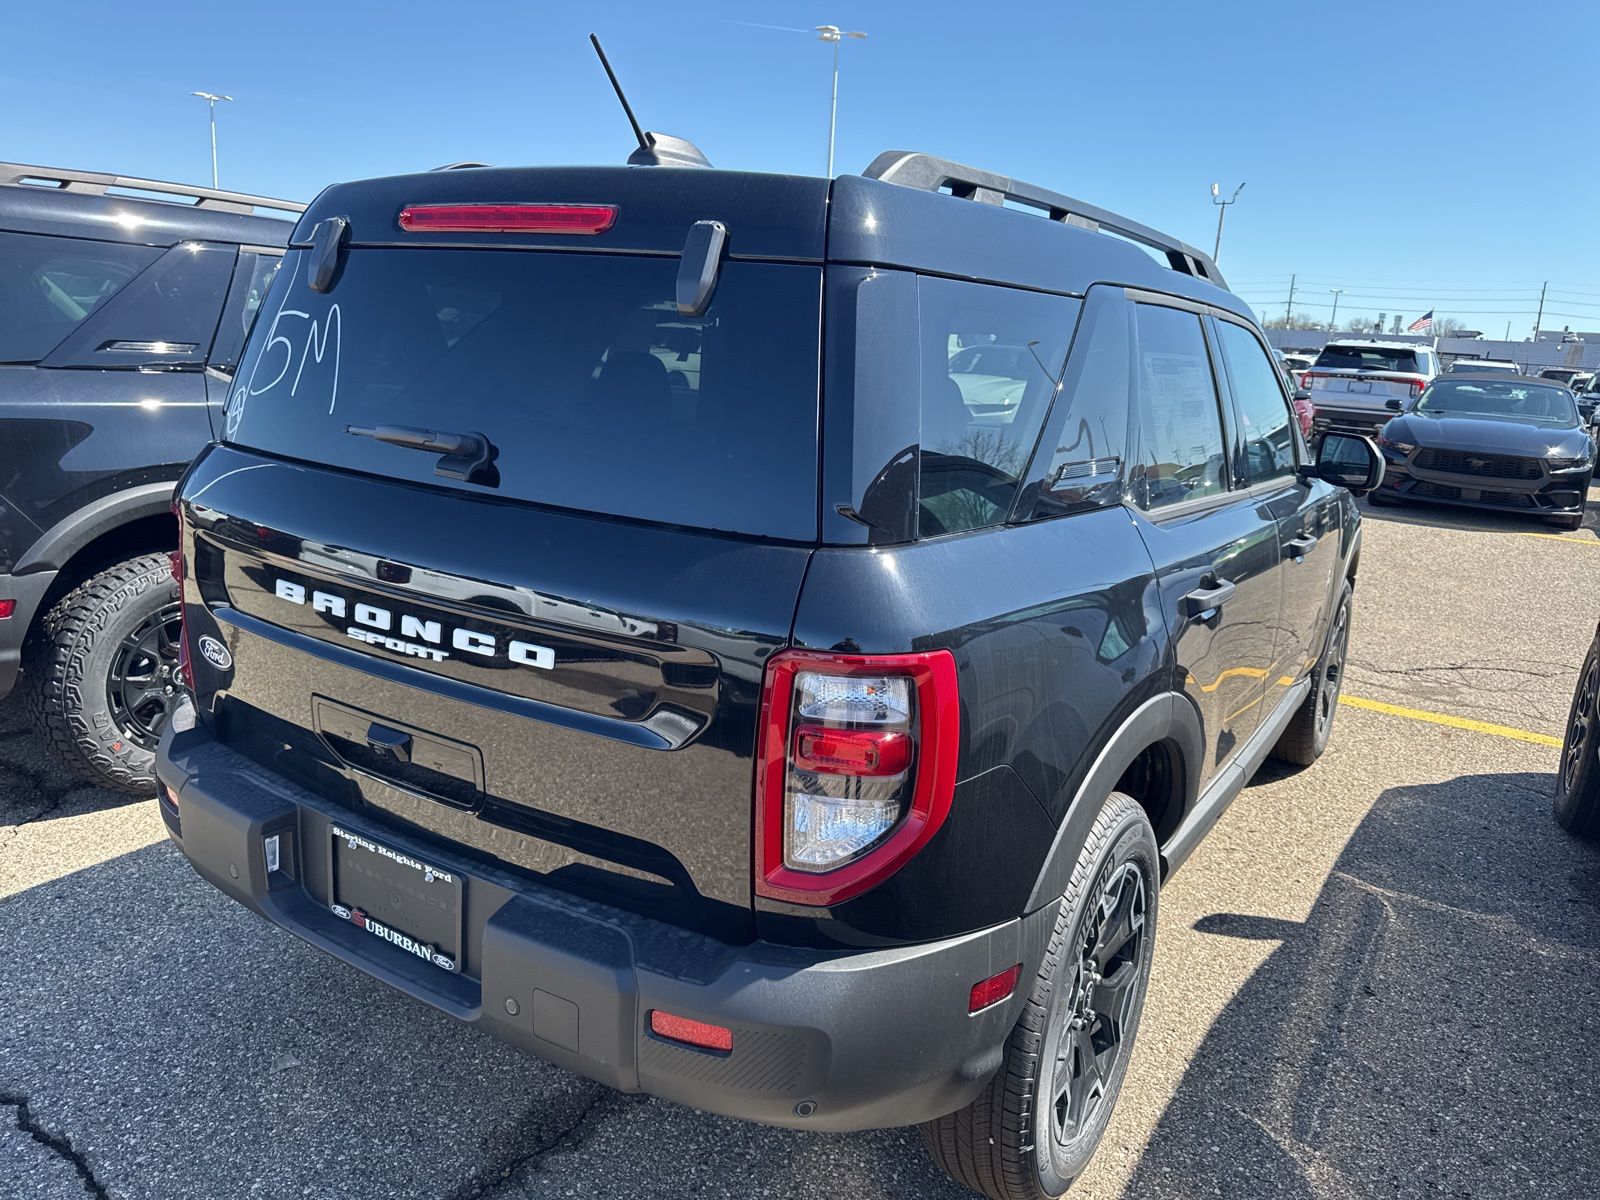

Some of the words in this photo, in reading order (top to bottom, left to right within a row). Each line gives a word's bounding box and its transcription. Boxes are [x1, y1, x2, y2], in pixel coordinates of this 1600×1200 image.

[275, 578, 555, 670] BRONCO
[347, 627, 449, 661] SPORT
[333, 827, 376, 853] Sterling
[377, 846, 422, 870] Heights
[424, 864, 452, 883] Ford
[352, 911, 431, 961] SUBURBAN
